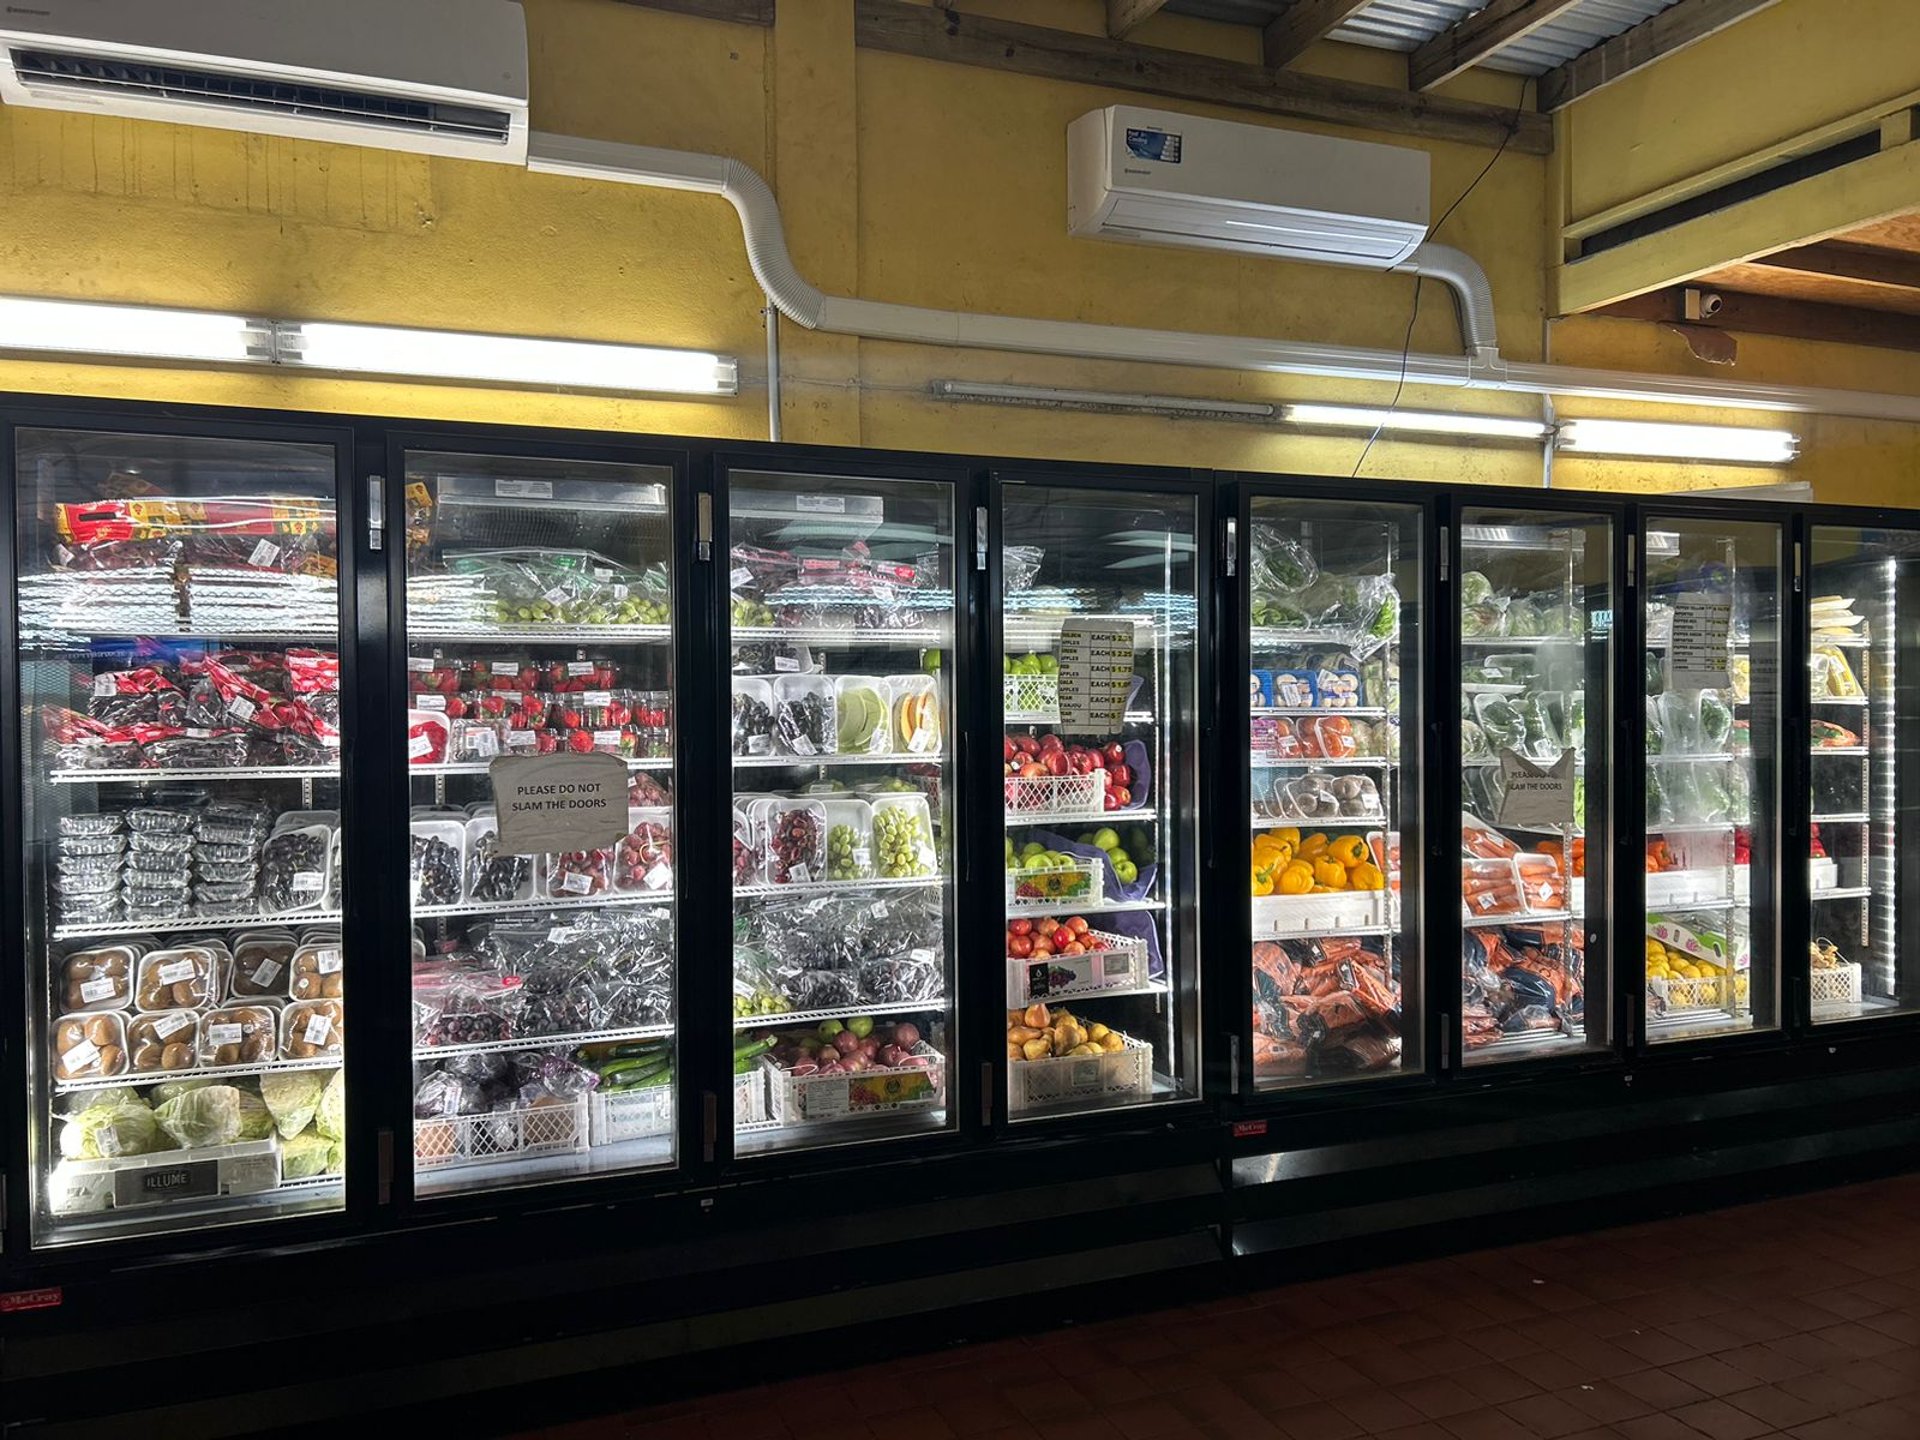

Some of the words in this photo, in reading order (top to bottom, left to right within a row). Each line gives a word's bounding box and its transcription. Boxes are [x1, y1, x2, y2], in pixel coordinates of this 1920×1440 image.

[517, 784, 556, 795] PLEASE
[559, 784, 575, 794] DO
[578, 783, 602, 793] NOT
[1527, 783, 1538, 791] THE
[1540, 783, 1562, 791] DOORS
[512, 801, 543, 812] SLAM
[545, 800, 566, 810] THE
[569, 798, 607, 809] DOORS
[146, 1173, 188, 1188] ILLUME
